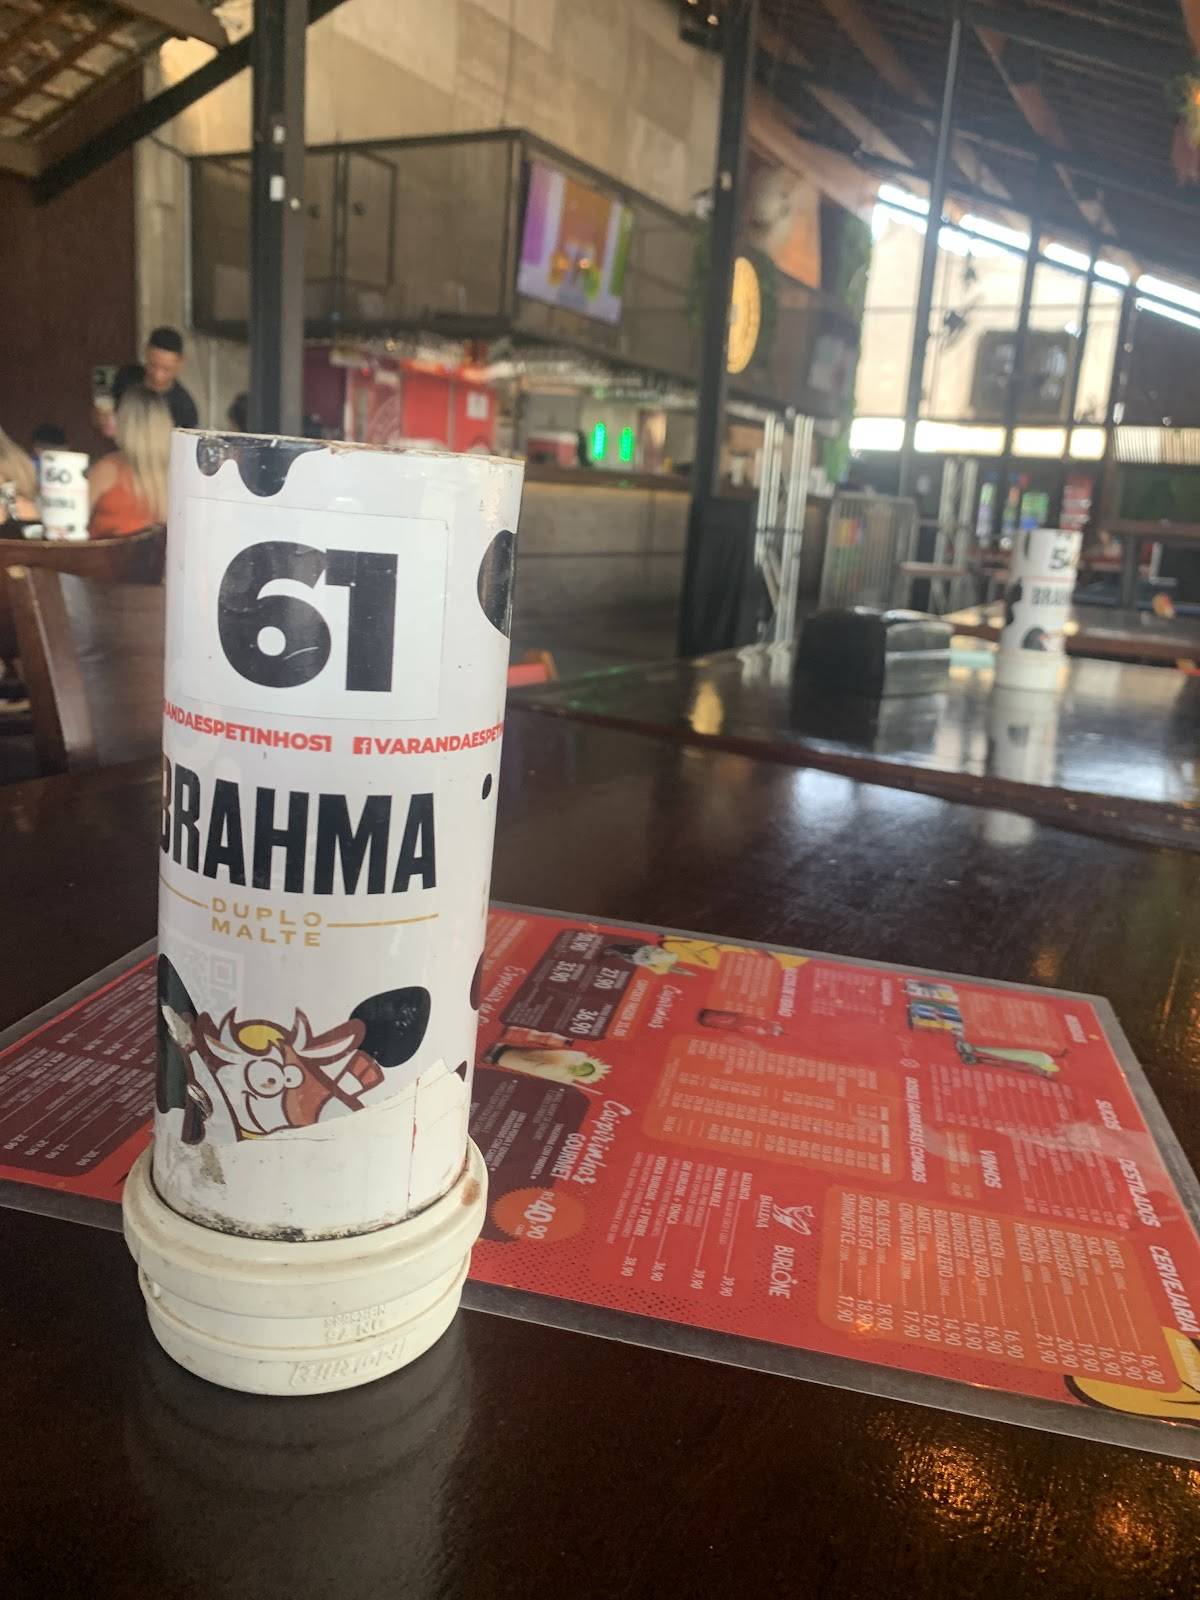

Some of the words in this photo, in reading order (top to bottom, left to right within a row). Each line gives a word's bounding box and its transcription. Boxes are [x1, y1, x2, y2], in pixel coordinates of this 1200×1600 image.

[217, 540, 399, 693] 61
[164, 700, 332, 752] ANDAESPETINHOS1
[212, 897, 323, 928] DUPLO
[211, 916, 322, 947] MALTE
[569, 1009, 598, 1034] 36,90
[550, 1133, 587, 1180] GOURMET
[572, 1100, 629, 1185] Caipirinhas
[980, 1150, 1002, 1188] VINHOS
[858, 1195, 873, 1213] SKOL
[876, 1198, 891, 1217] SKOL
[1118, 1158, 1161, 1227] DESTILADOS
[756, 1195, 773, 1228] BALLENA
[858, 1214, 873, 1238] BEATS
[899, 1203, 914, 1235] CORONA
[917, 1206, 932, 1234] AMSTEL
[877, 1217, 891, 1248] SENSES
[901, 1235, 916, 1261] EXTRA
[933, 1209, 950, 1256] BUDWEISER
[969, 1215, 986, 1255] HEINEKEN
[621, 1255, 637, 1276] 38,90
[650, 1261, 666, 1281] 36,90
[690, 1268, 705, 1289] 39,90
[938, 1256, 954, 1278] ZERO
[950, 1212, 970, 1259] BUDWEISER
[963, 1321, 982, 1350] 14,90
[974, 1255, 990, 1278] ZERO
[720, 1275, 735, 1296] 39,90
[986, 1219, 1004, 1257] HEINEKEN
[1003, 1329, 1024, 1359] 16,90
[1013, 1222, 1034, 1263] HEINEKEN
[1035, 1333, 1058, 1364] 21,90
[1030, 1226, 1052, 1264] ORIGINAL
[1056, 1337, 1078, 1368] 20,90
[1048, 1229, 1073, 1278] BUDWEISER
[1077, 1342, 1100, 1371] 19,90
[1149, 1245, 1200, 1333] CERVEJARIA
[837, 1295, 854, 1322] 17,90
[856, 1299, 873, 1326] 18,90
[876, 1303, 893, 1330] 18,90
[1065, 1232, 1088, 1268] BRAHMA
[1098, 1346, 1121, 1376] 16,90
[1084, 1236, 1103, 1256] SKOL
[1119, 1350, 1142, 1380] 16,90
[1102, 1239, 1124, 1269] AMSTEL
[1140, 1354, 1165, 1384] 16,90
[903, 1310, 921, 1338] 17,90
[924, 1313, 941, 1341] 12,90
[943, 1317, 962, 1346] 14,90
[985, 1325, 1003, 1353] 16,90
